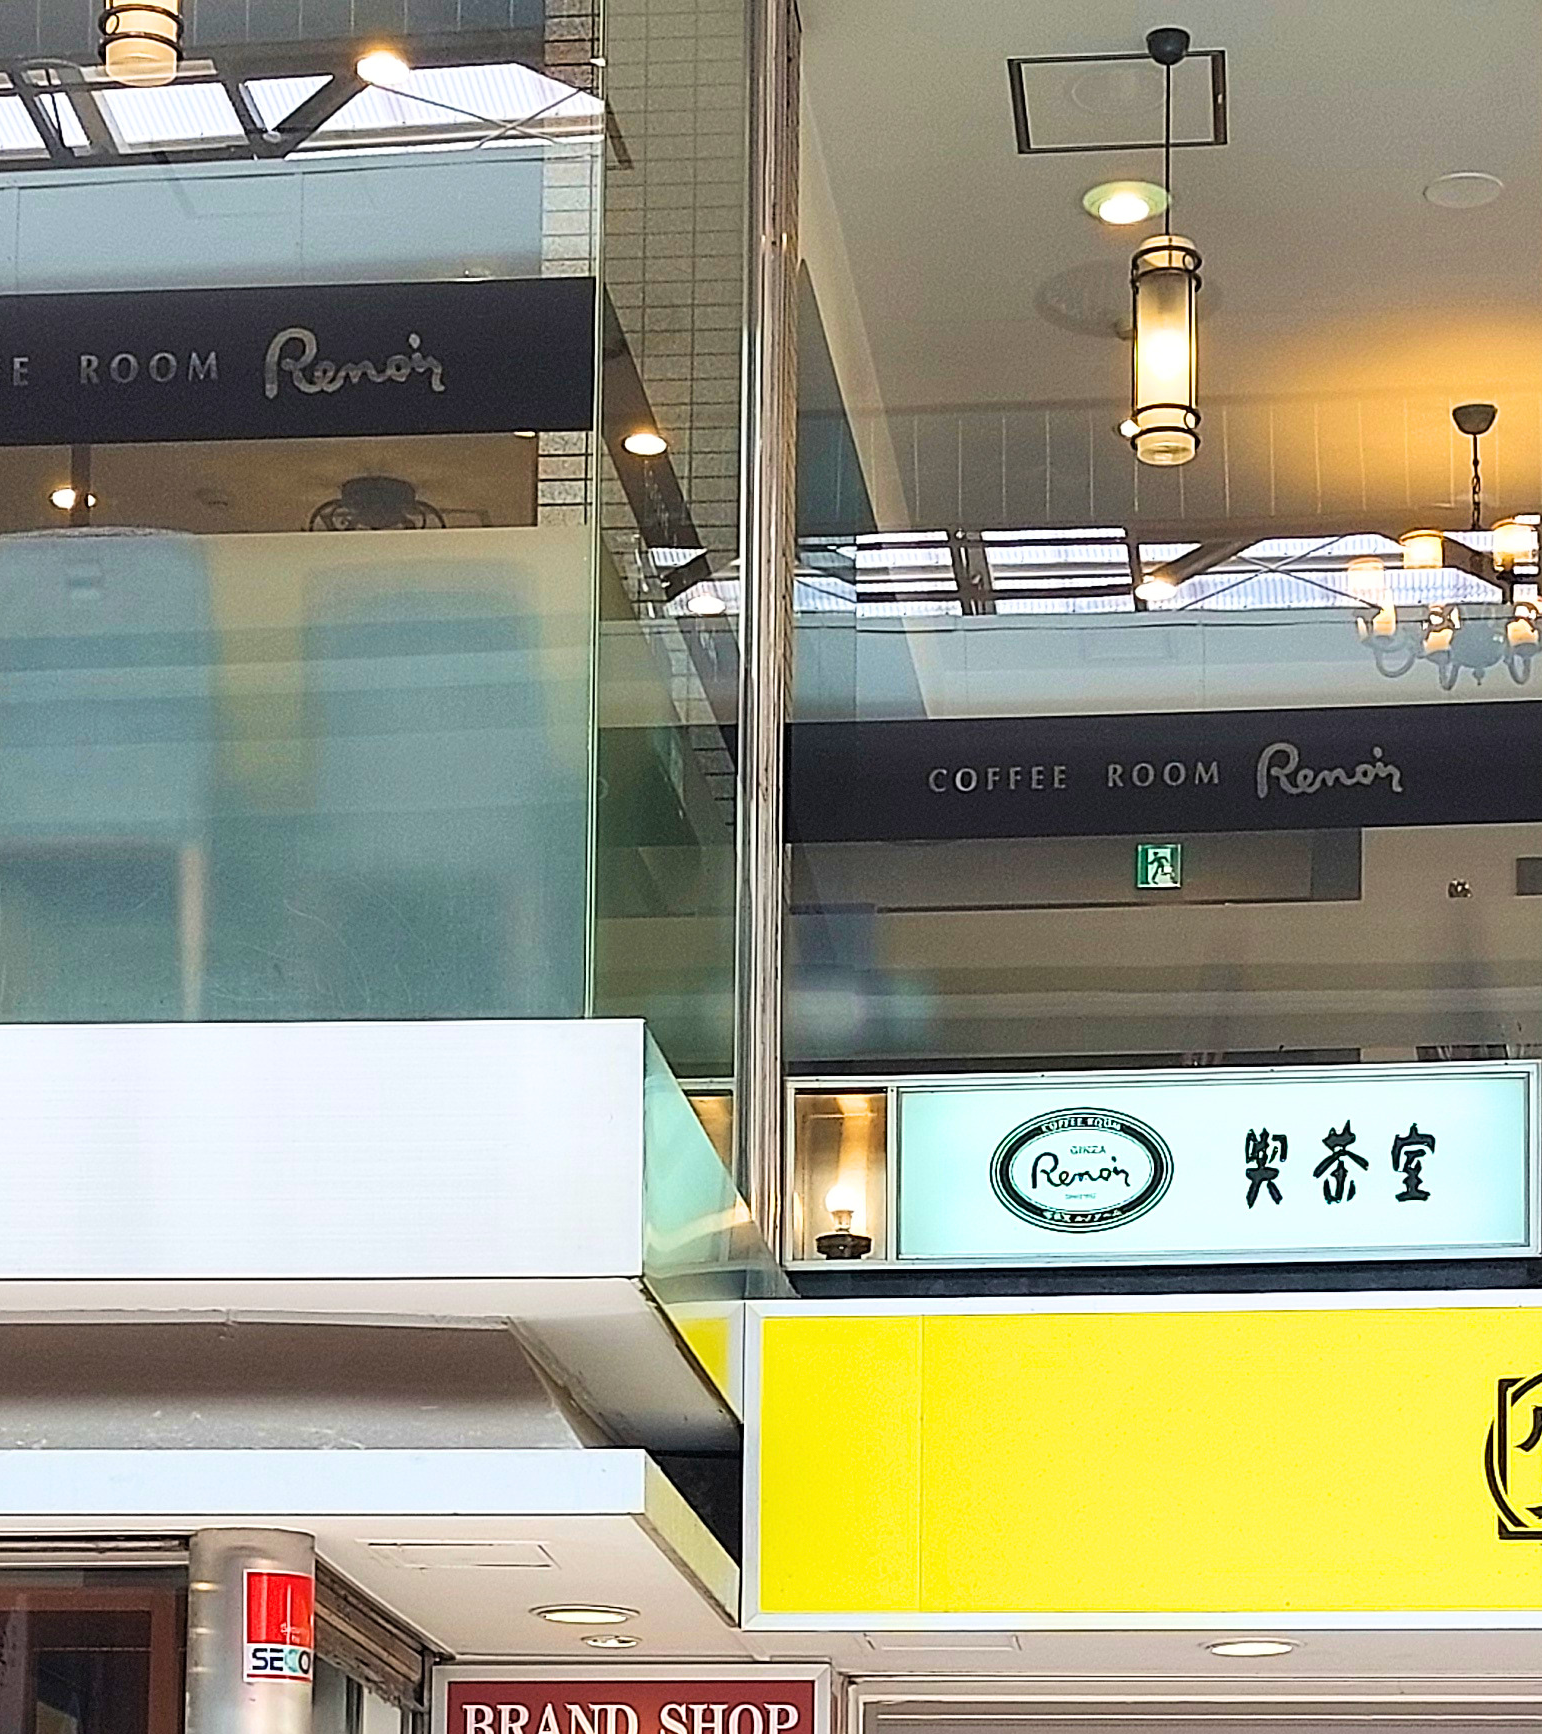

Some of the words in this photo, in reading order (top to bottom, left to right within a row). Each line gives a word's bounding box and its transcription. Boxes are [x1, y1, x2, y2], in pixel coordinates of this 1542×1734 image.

[78, 350, 220, 385] ROOM
[263, 326, 444, 399] Renoir
[928, 763, 1069, 794] COFFEE
[1107, 759, 1221, 788] ROOM
[1256, 741, 1403, 800] Renoir
[1031, 1151, 1131, 1189] Renoir
[1069, 1145, 1107, 1155] GINZA
[1244, 1119, 1436, 1208] 喫茶室
